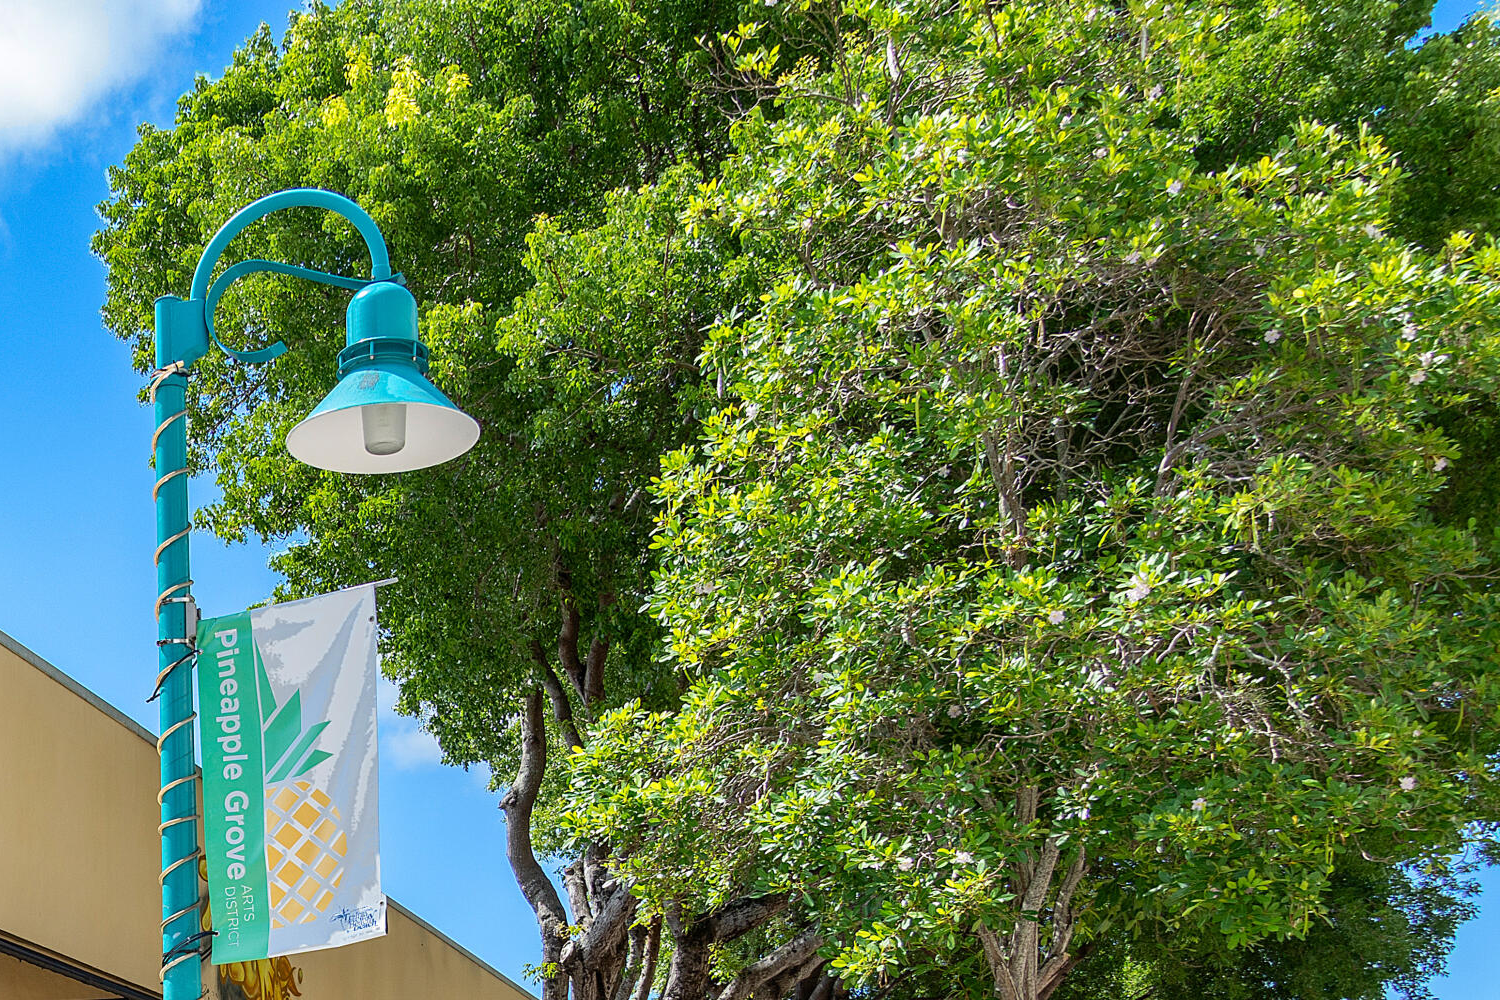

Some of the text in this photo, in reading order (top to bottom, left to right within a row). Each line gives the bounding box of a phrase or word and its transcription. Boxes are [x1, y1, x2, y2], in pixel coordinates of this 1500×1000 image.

[214, 628, 249, 881] Pineapple Grove
[224, 886, 240, 948] DISTRICT
[240, 884, 255, 922] ARTS
